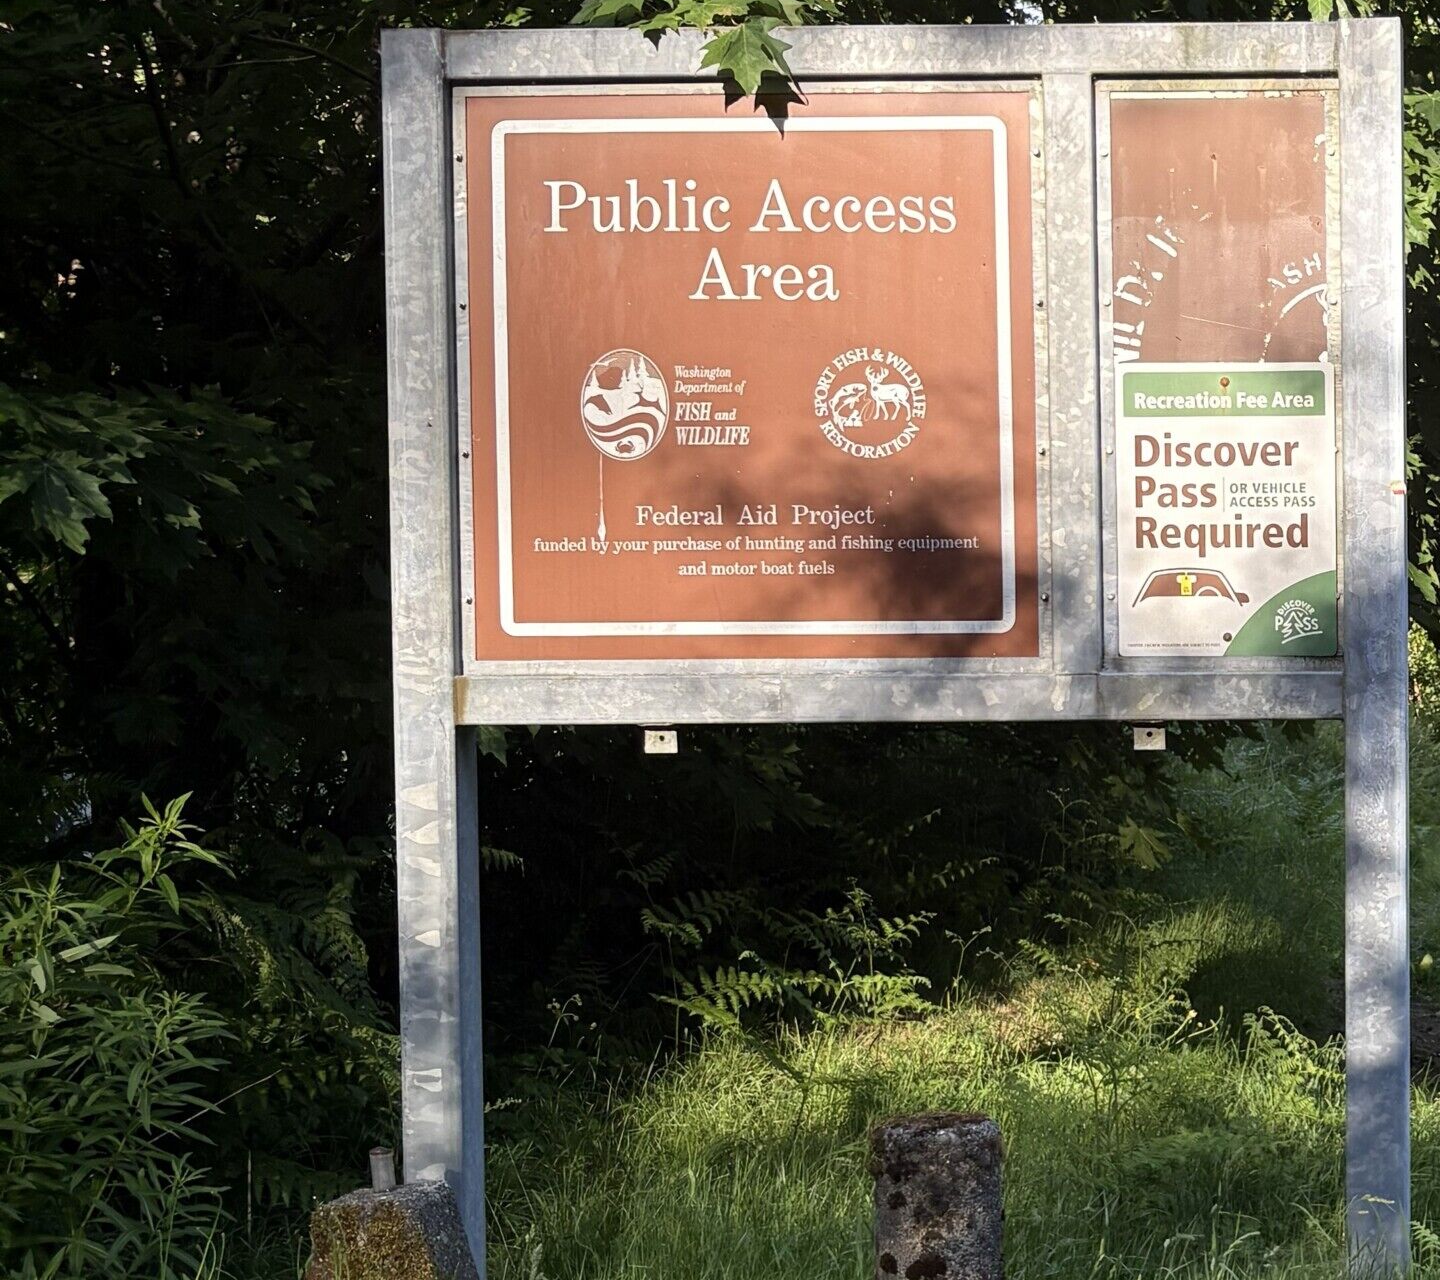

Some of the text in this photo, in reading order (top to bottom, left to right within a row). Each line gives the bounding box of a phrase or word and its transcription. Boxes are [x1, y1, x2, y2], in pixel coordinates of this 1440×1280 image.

[543, 179, 957, 234] Public Access
[689, 247, 840, 302] Area
[674, 365, 732, 381] Washington
[814, 347, 927, 419] SPORT FISH & WILDLIFE
[674, 380, 747, 396] Department of
[1134, 391, 1314, 410] Recreation Fee Area
[675, 402, 737, 421] FISH and
[675, 426, 750, 446] WILDLIFE
[819, 420, 920, 459] RESTORATION
[1134, 432, 1299, 468] Discover
[1135, 475, 1217, 508] Pass
[1229, 482, 1306, 495] OR VEHICLE
[1229, 495, 1316, 508] ACCESS PASS
[635, 504, 876, 530] Federal Aid Project
[533, 535, 980, 555] funded by your purchase of hunting and fishing equipment
[1135, 513, 1309, 558] Required
[678, 560, 836, 576] and motor boat fuels
[1277, 599, 1316, 616] DISCOVER
